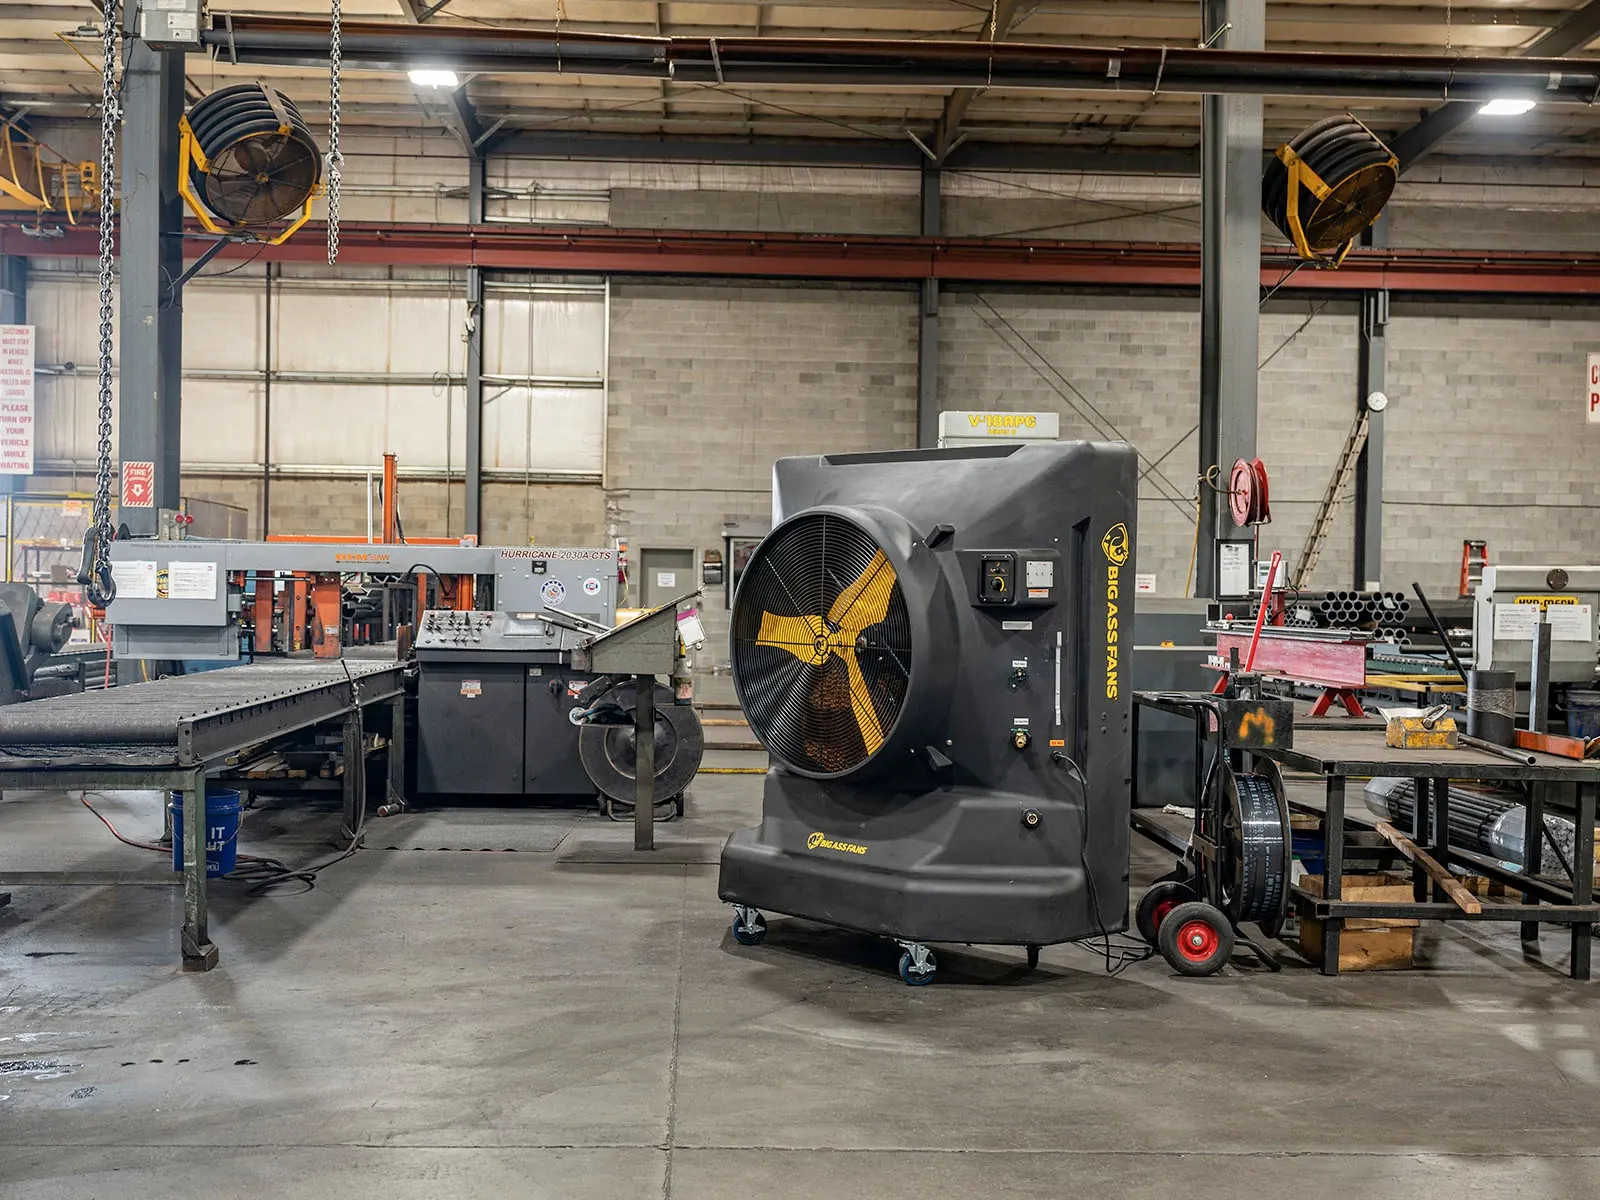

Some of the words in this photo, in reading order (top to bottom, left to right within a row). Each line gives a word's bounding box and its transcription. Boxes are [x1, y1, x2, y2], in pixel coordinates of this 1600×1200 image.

[2, 404, 29, 412] PLEASE
[0, 415, 17, 423] TURN
[19, 415, 32, 423] OFF
[1107, 566, 1119, 600] BIG
[1107, 602, 1118, 644] ASS
[1106, 645, 1118, 699] FANS
[211, 826, 225, 840] IT
[820, 840, 833, 849] BIG
[832, 842, 848, 851] ASS
[846, 844, 868, 855] FANS
